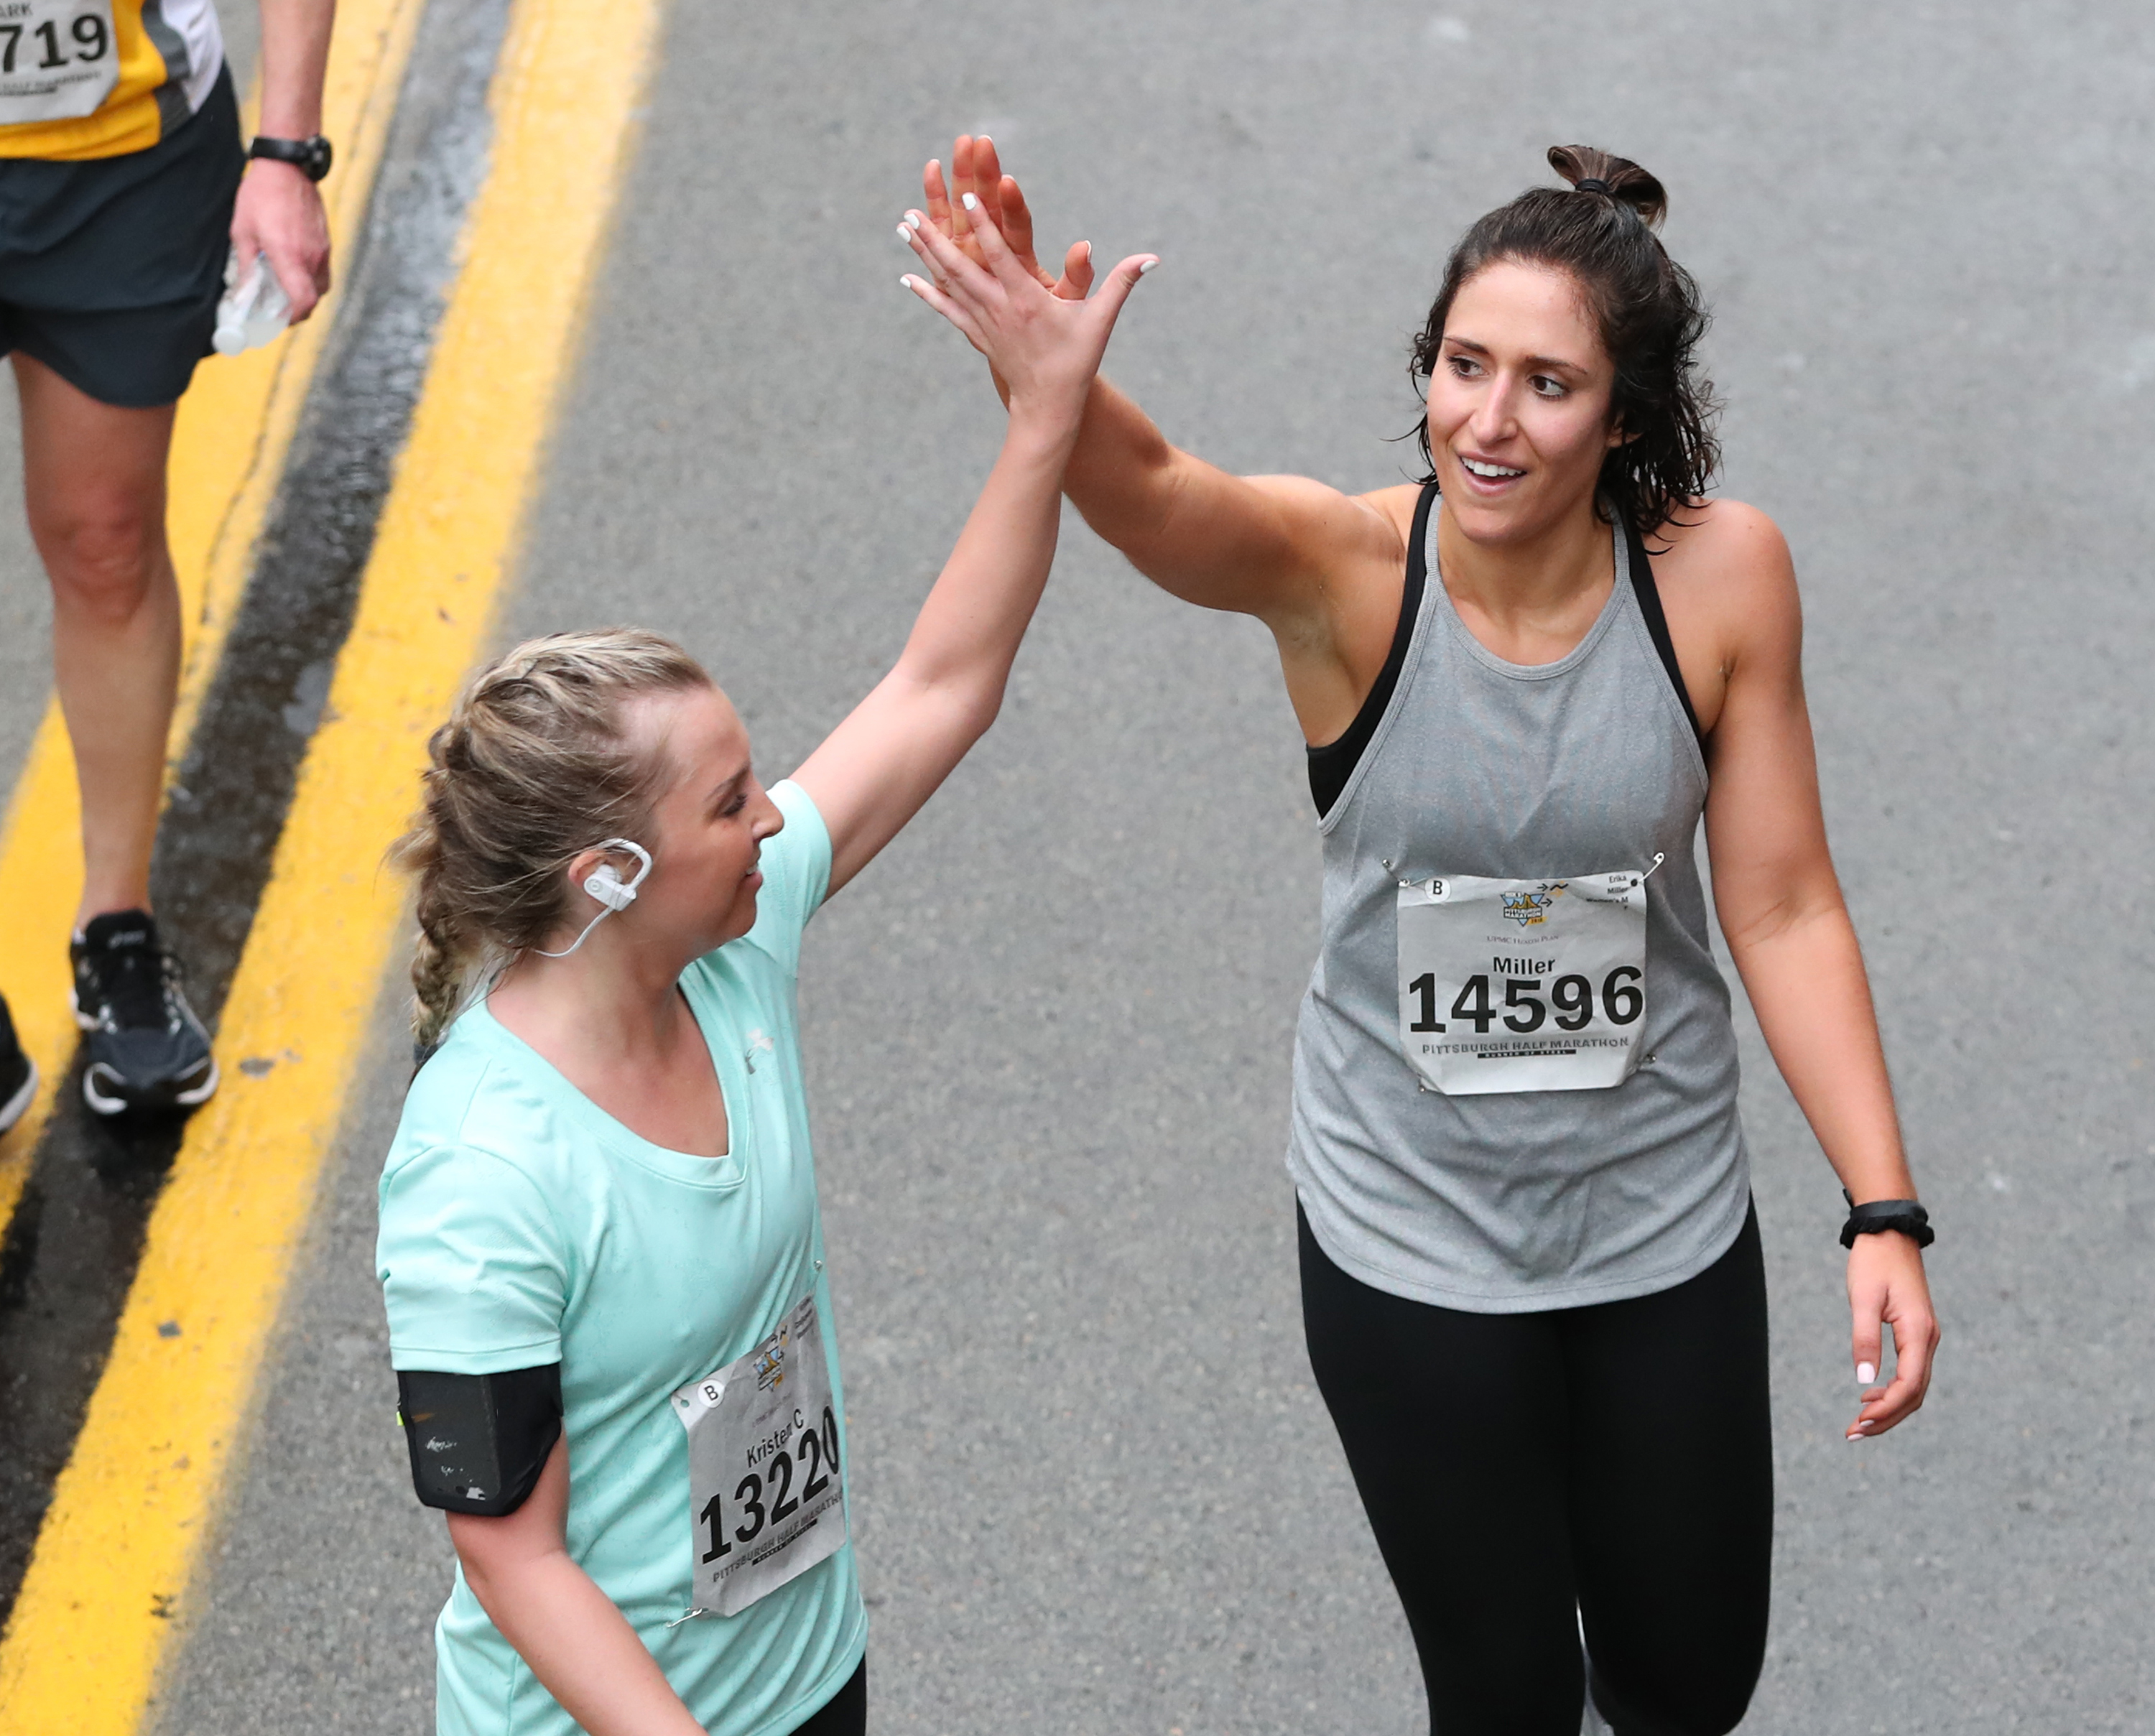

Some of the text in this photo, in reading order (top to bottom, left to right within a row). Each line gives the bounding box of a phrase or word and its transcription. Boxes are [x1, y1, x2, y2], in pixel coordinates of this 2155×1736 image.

[0, 14, 107, 73] 719
[1432, 881, 1443, 896] B
[1609, 875, 1627, 883] Erika
[1493, 956, 1556, 975] Miller
[1409, 966, 1644, 1034] 14596
[1422, 1036, 1629, 1054] PITTSBURGH HALF MARATHON
[705, 1385, 719, 1401] B
[793, 1408, 804, 1429] C
[700, 1406, 839, 1564] 13220
[713, 1537, 775, 1582] PITTSBURGH
